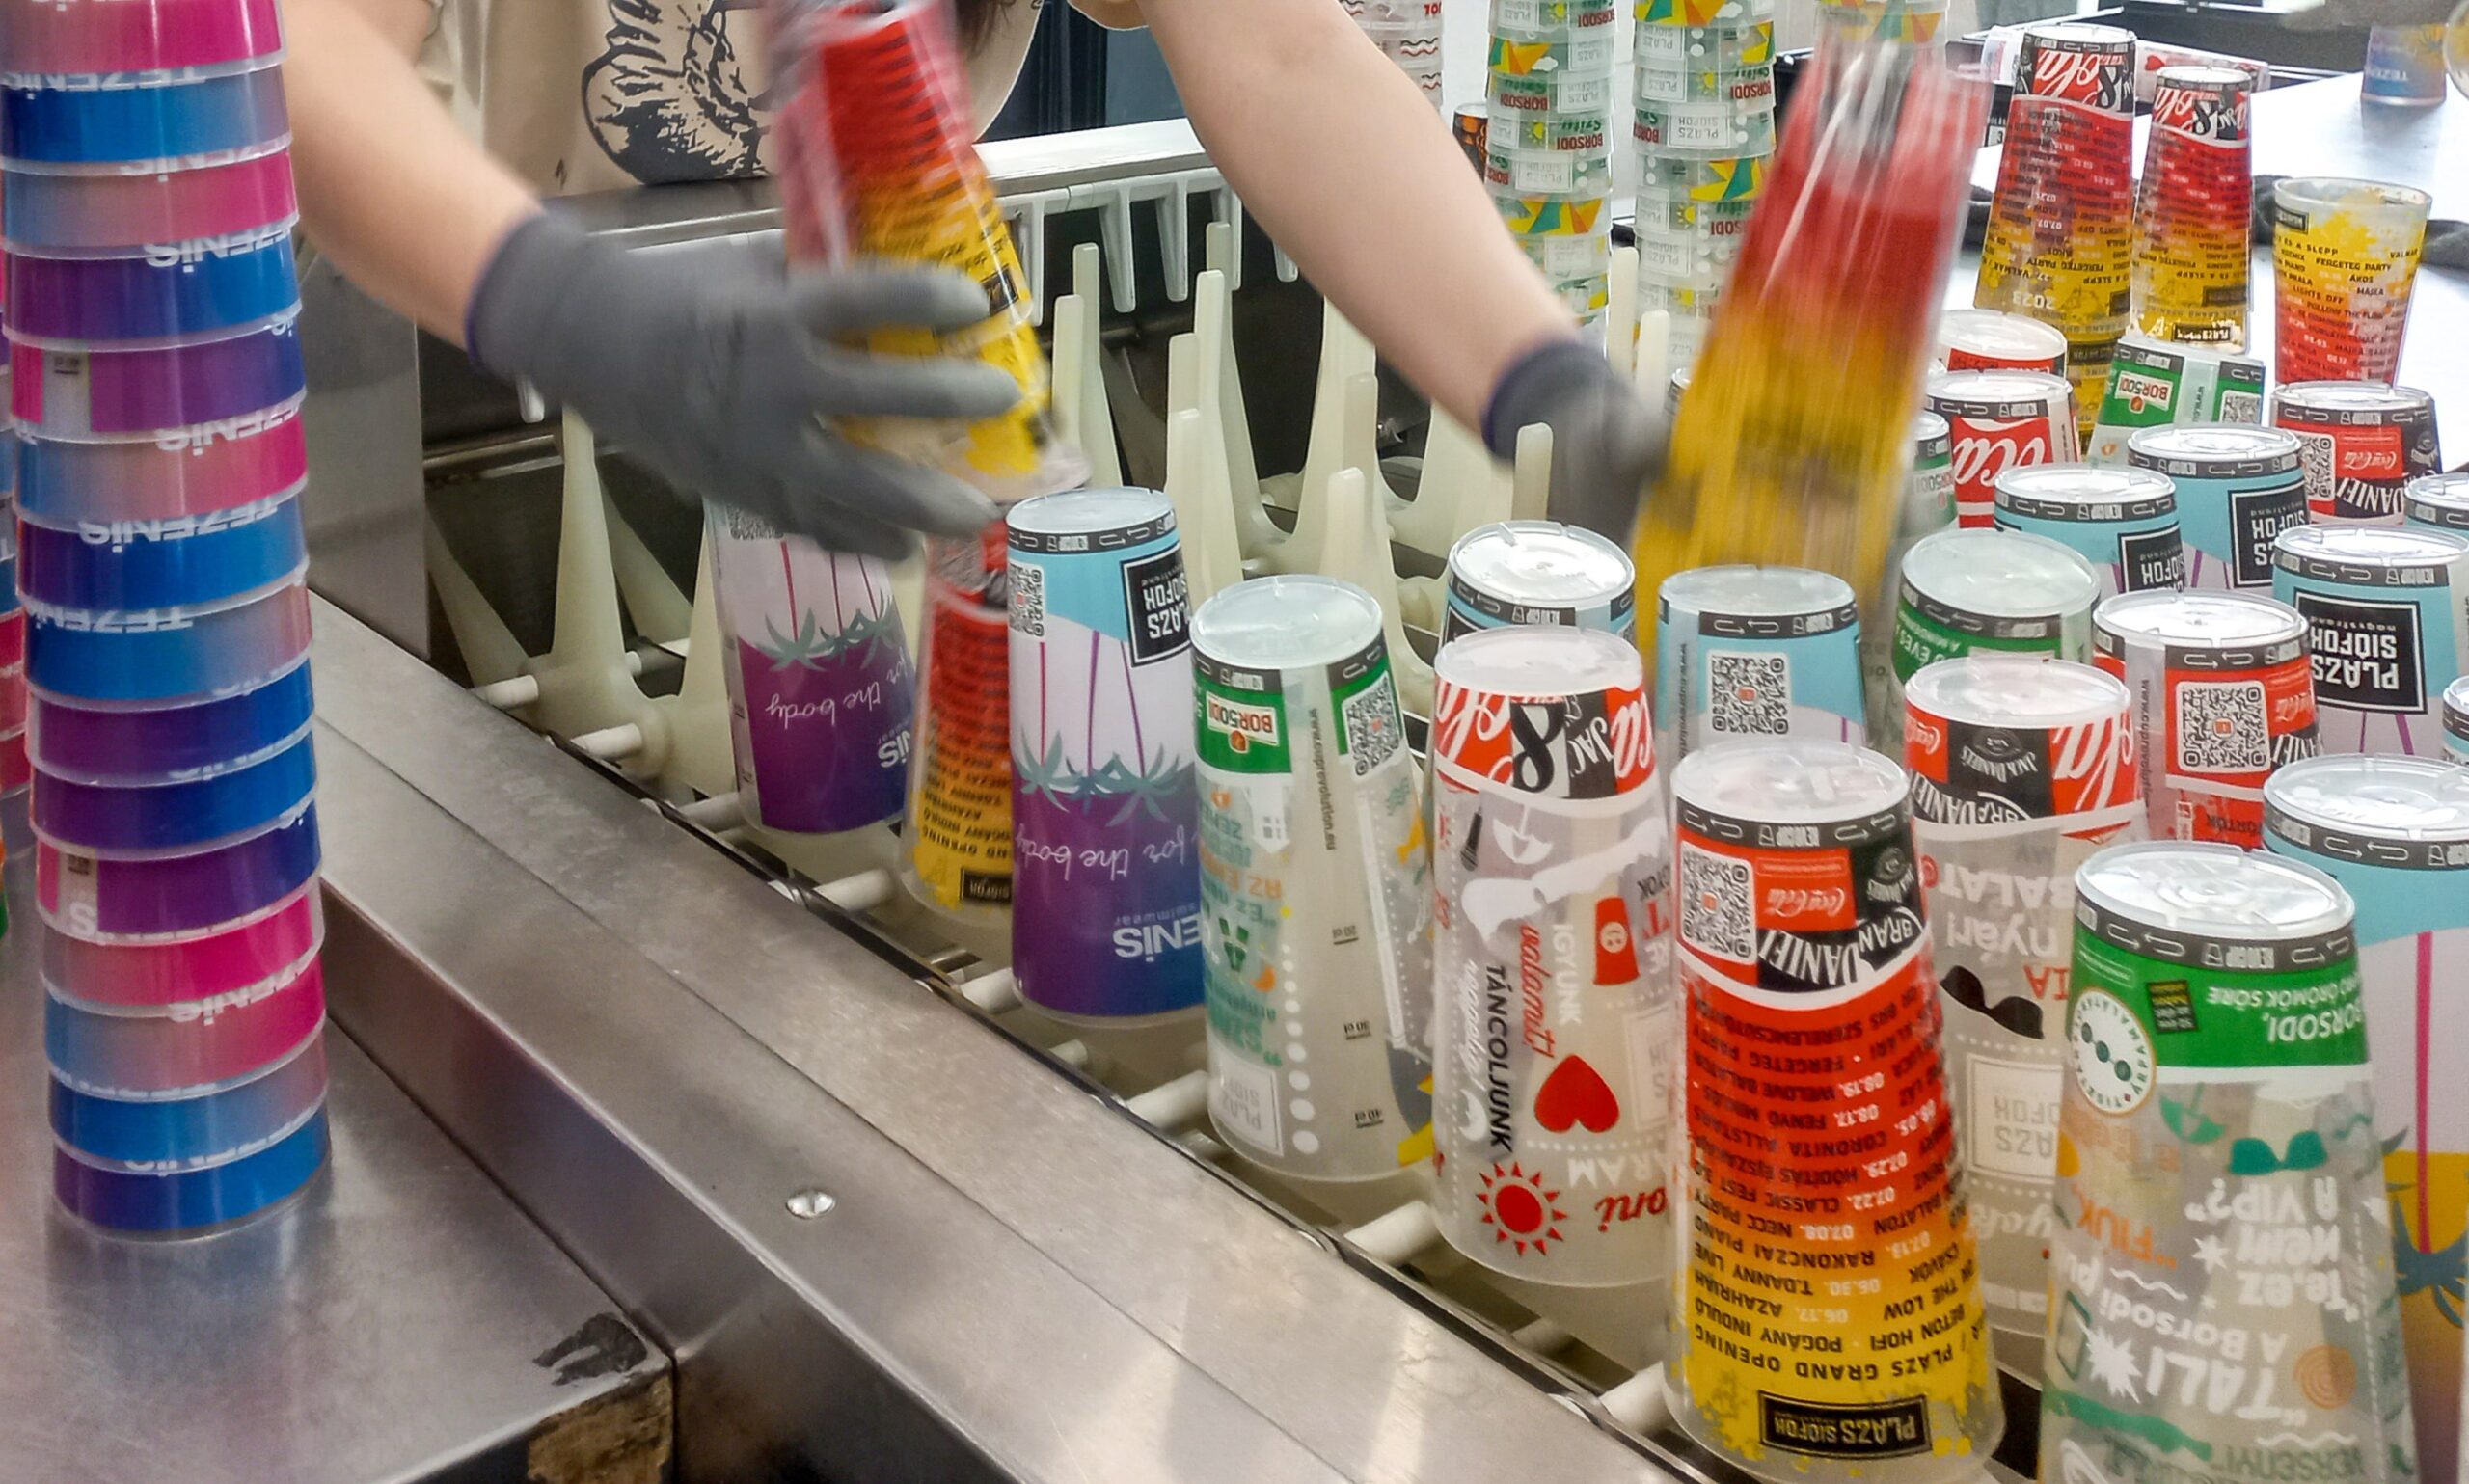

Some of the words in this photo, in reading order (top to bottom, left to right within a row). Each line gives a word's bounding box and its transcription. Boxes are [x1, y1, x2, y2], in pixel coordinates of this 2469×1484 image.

[765, 693, 836, 731] body
[843, 680, 881, 712] the
[1014, 823, 1072, 881] body
[1078, 848, 1130, 882] the
[1764, 887, 1846, 918] Coca-Cola
[1486, 965, 1513, 1154] TÁNCOLJUNK
[1787, 1130, 1888, 1158] CORONITA
[1720, 1177, 1758, 1204] FEST
[1764, 1192, 1841, 1214] CLASSIC
[1846, 1185, 1896, 1212] 07.22.
[1694, 1187, 1742, 1227] PARTY
[1694, 1214, 1745, 1255] PIANO
[1754, 1243, 1876, 1270] RAKONCZAI
[1694, 1271, 1784, 1318] AZAHRIAH
[1731, 1264, 1814, 1297] T.DANNY
[1823, 1278, 1882, 1296] 06.30.
[1883, 1294, 1925, 1321] LOW
[1869, 1323, 1914, 1351] HOFI
[2097, 1287, 2248, 1362] Borsodi
[1694, 1323, 1781, 1373] OPENING
[1795, 1361, 1879, 1381] GRAND
